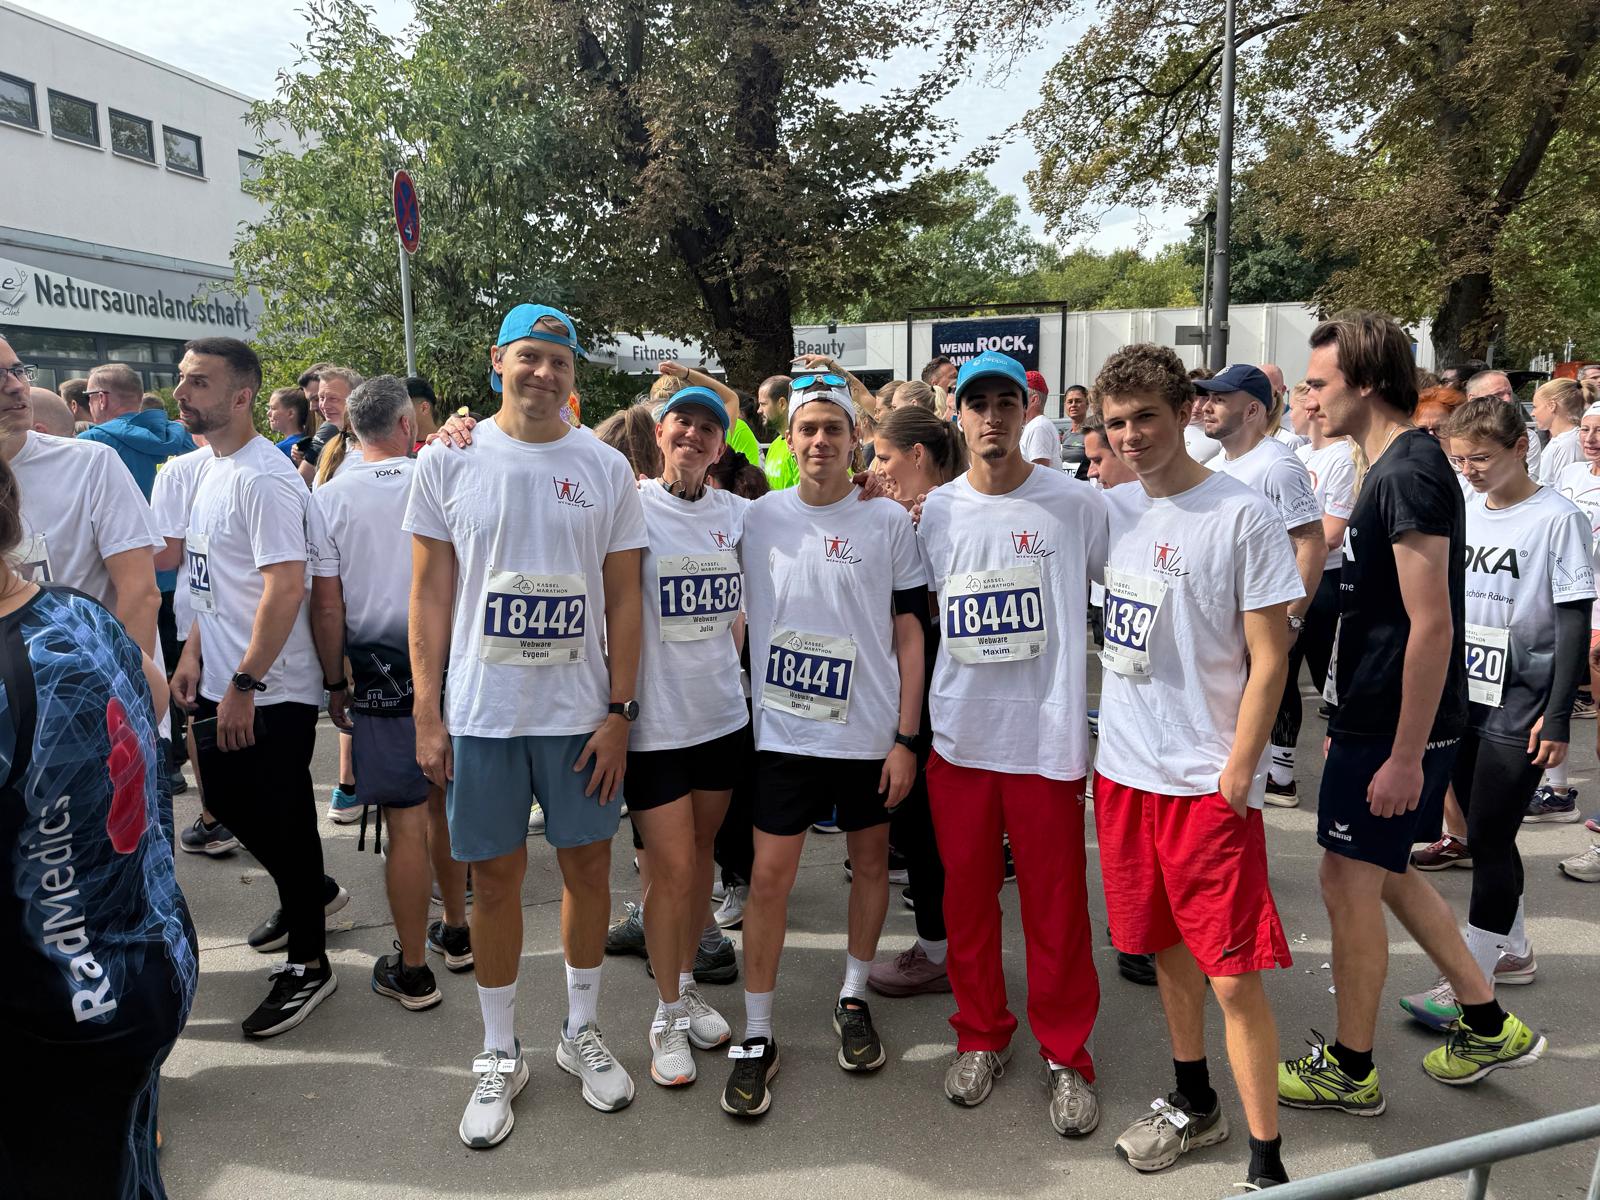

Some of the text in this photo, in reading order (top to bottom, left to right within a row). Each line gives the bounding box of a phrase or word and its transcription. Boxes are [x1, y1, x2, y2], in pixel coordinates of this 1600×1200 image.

[34, 272, 250, 327] Natursaunalandschaft
[940, 335, 1034, 354] WENN ROCK,
[633, 345, 678, 361] Fitness
[949, 355, 975, 366] ANN
[375, 469, 402, 478] JOKA
[662, 576, 740, 614] 18438
[488, 596, 584, 635] 18442
[949, 591, 1040, 635] 18440
[700, 624, 714, 633] Julia
[1106, 599, 1152, 647] 439
[520, 640, 552, 648] Webware
[977, 636, 1008, 645] Webware
[522, 650, 550, 660] Evgenii
[803, 646, 833, 654] MARATHON
[982, 648, 1011, 657] Maxim
[771, 649, 847, 697] 18441
[28, 795, 118, 1023] RadMedics
